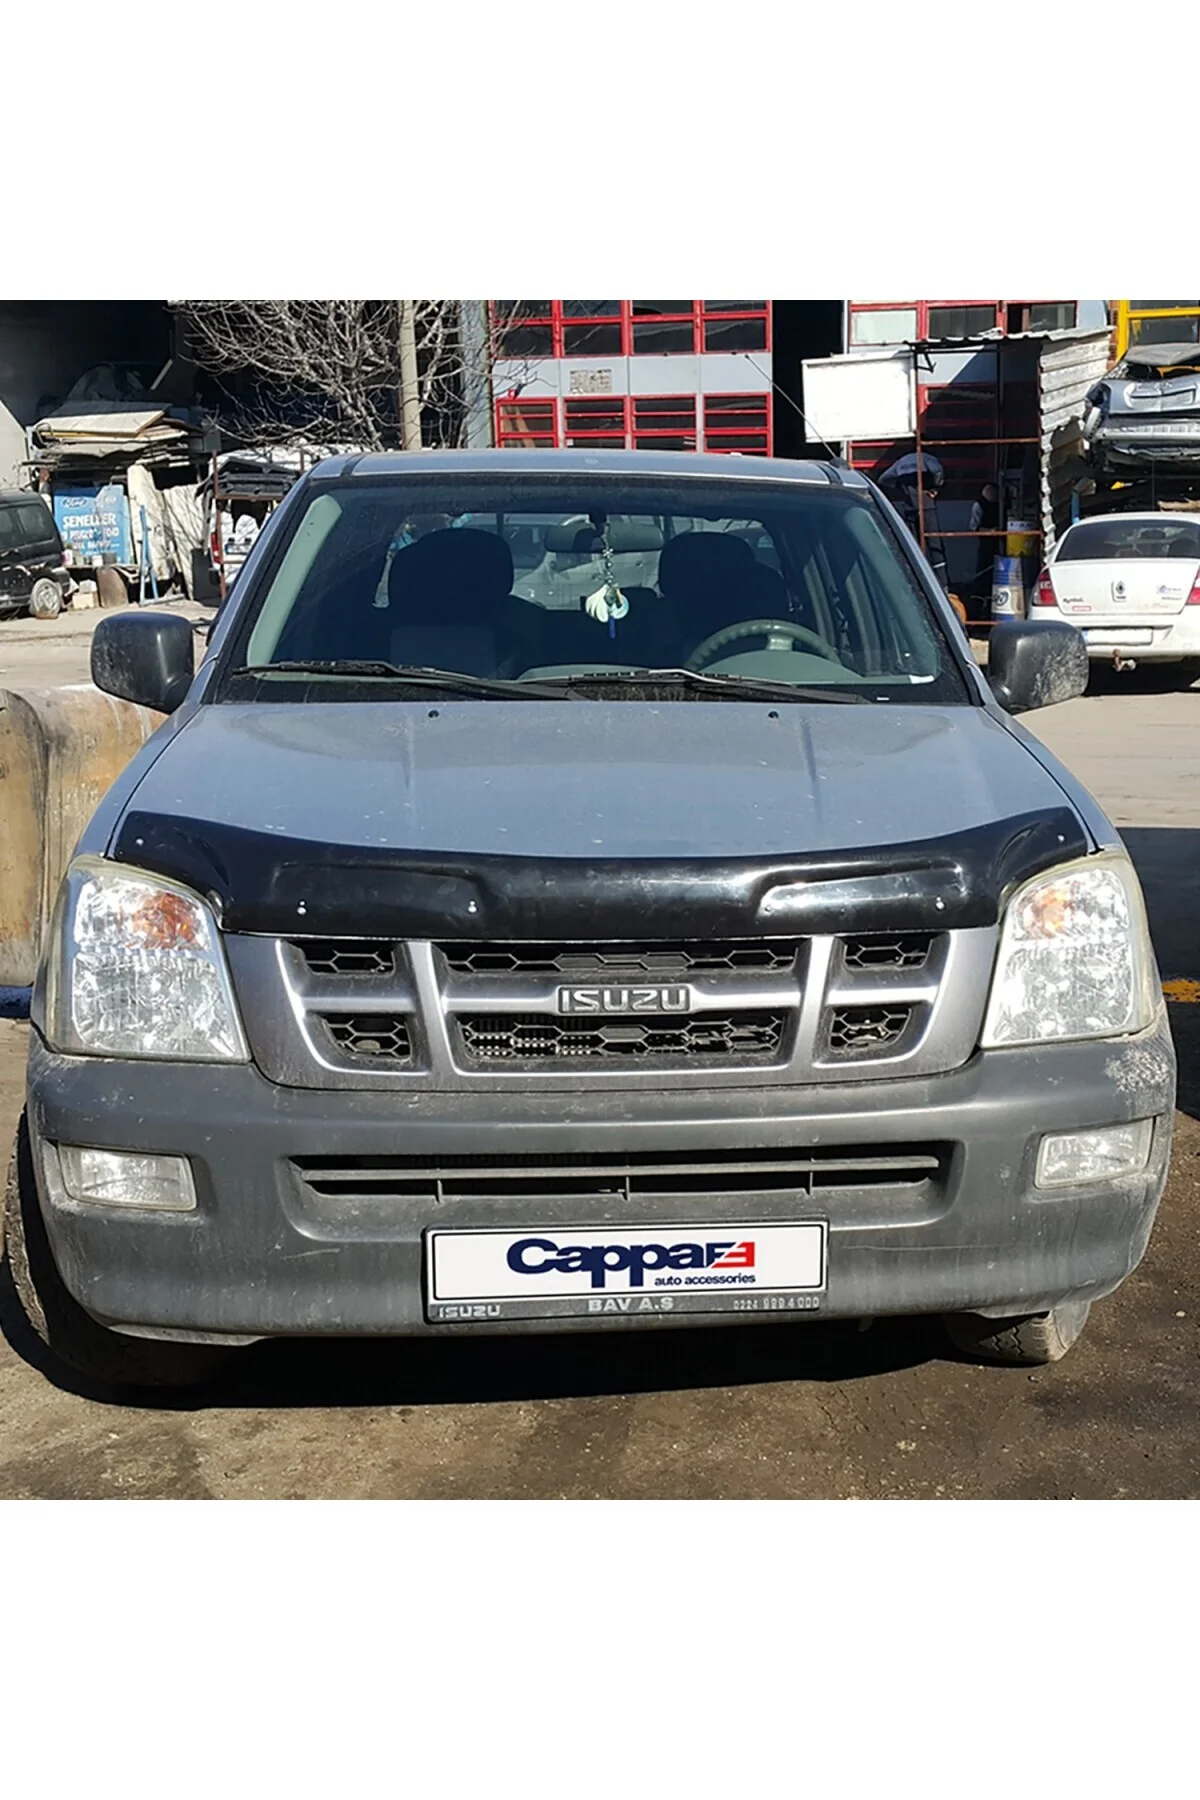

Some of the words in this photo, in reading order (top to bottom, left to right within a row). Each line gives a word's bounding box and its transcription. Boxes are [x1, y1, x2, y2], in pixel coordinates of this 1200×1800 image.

[561, 989, 688, 1012] ISUZU
[654, 1275, 682, 1287] auto
[685, 1272, 756, 1285] accessories
[439, 1304, 501, 1318] ISUZU
[588, 1298, 632, 1312] BAV
